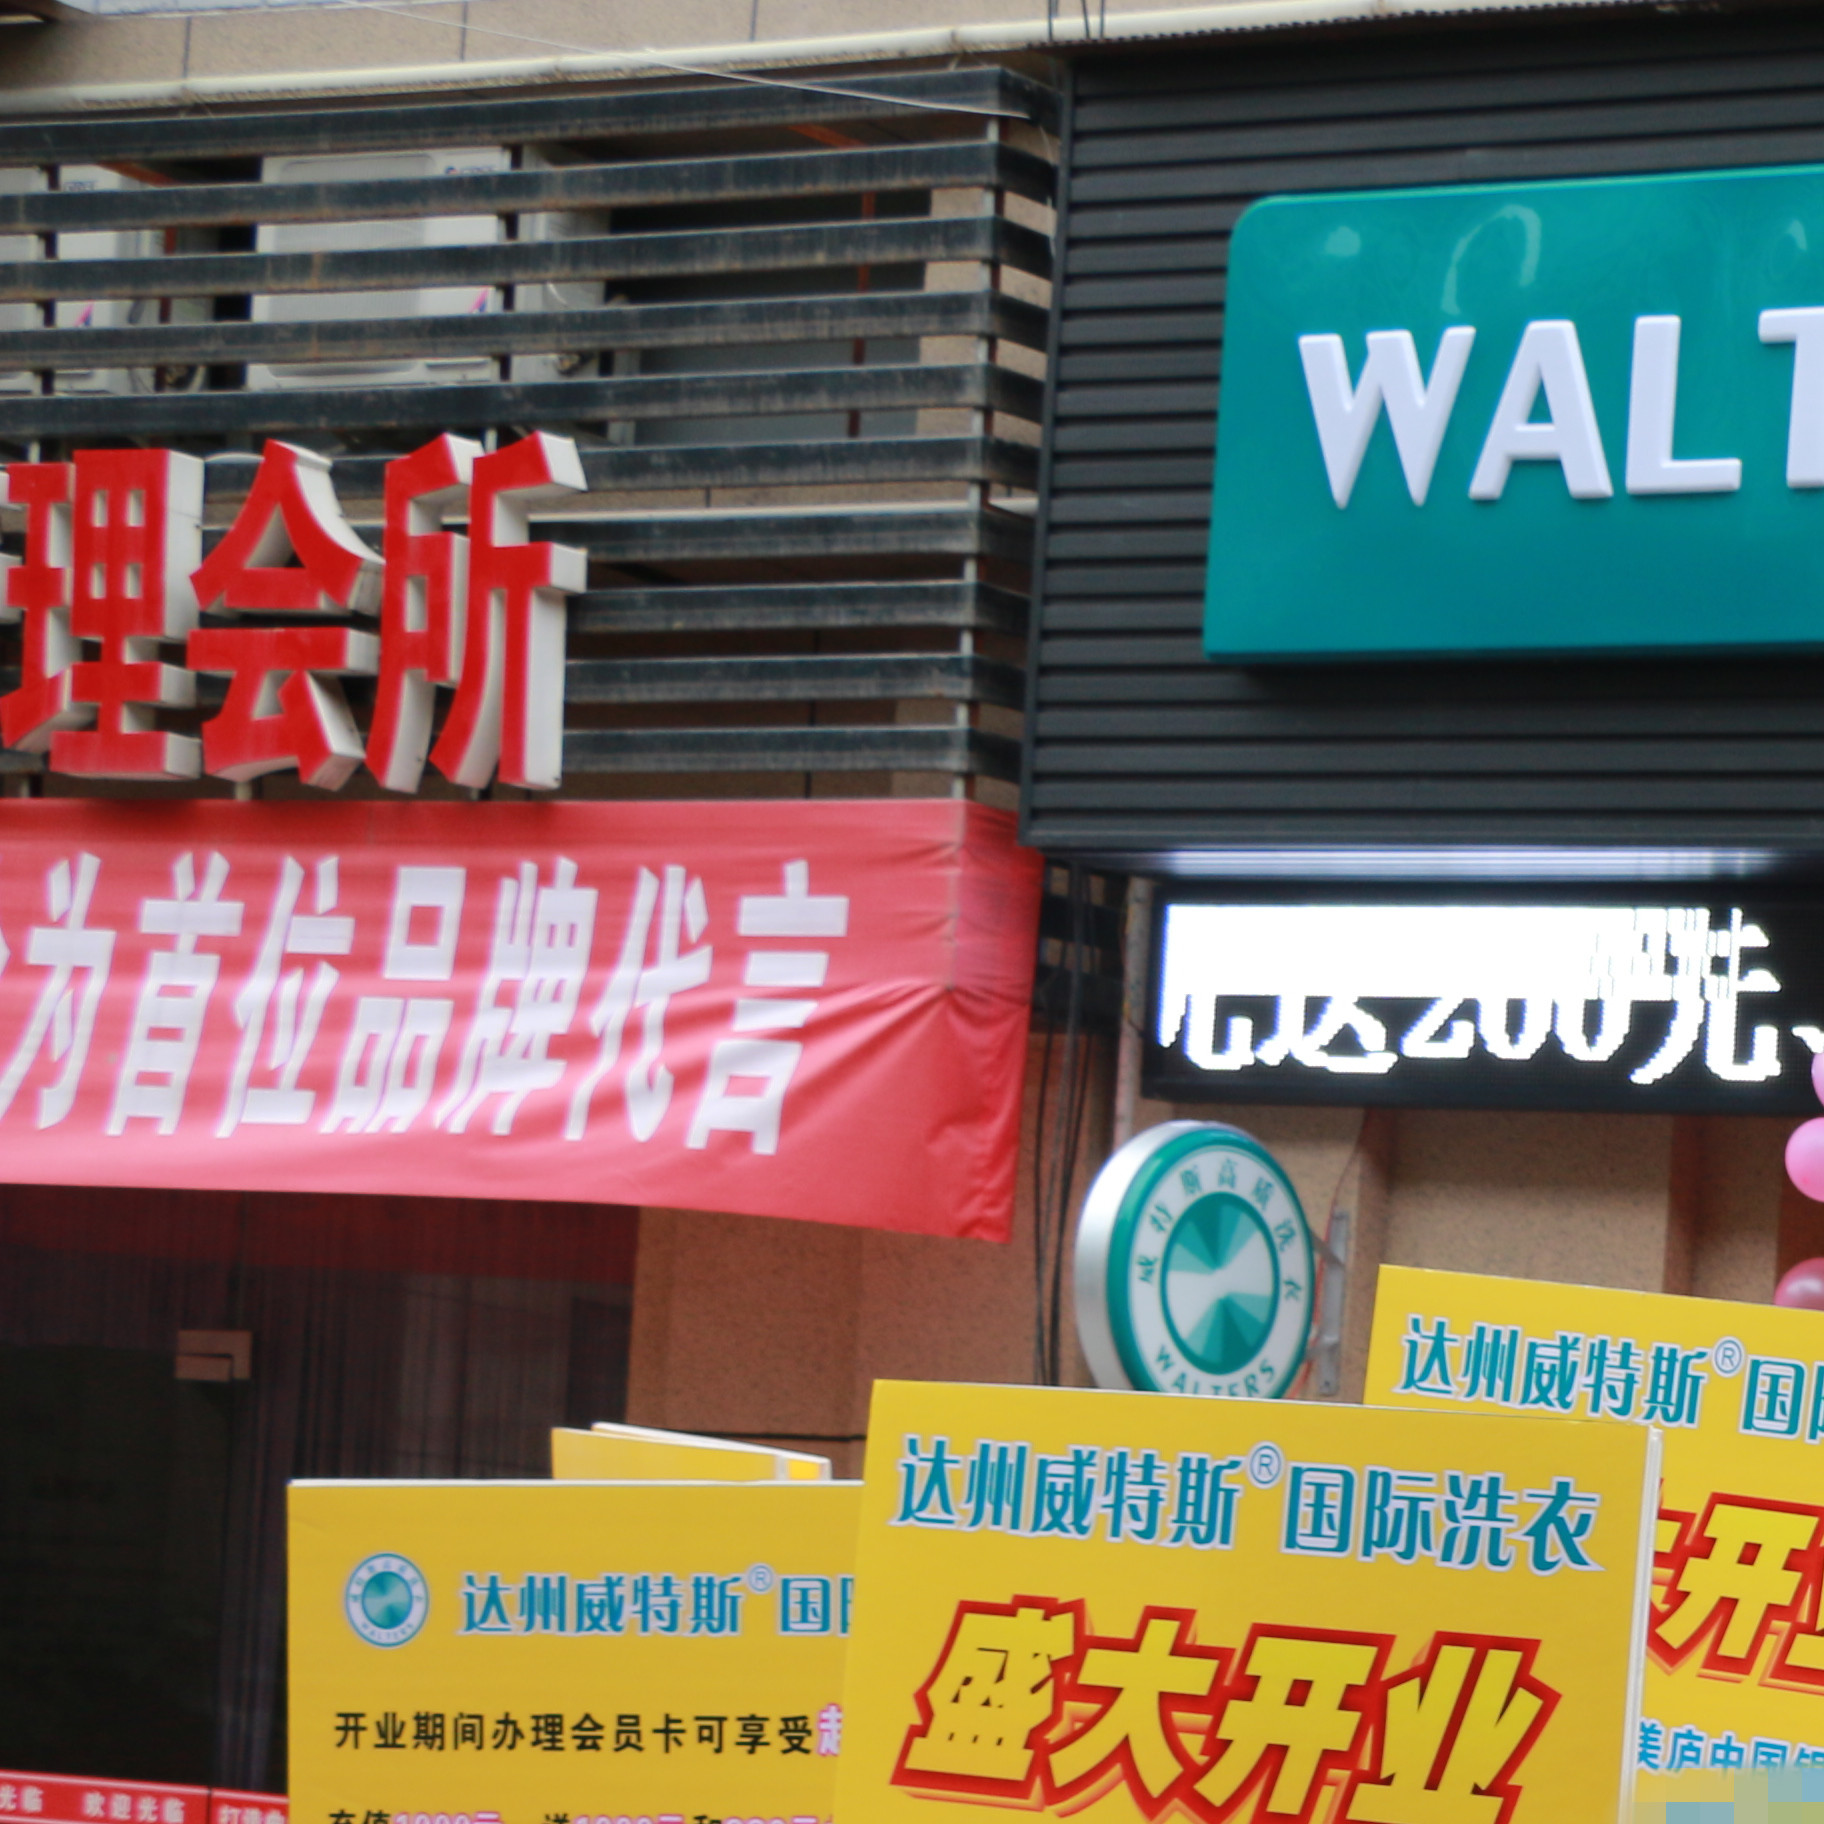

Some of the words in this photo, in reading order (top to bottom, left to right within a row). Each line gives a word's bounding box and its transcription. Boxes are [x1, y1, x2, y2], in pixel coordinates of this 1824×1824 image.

[0, 432, 587, 791] 理会所
[0, 850, 850, 1157] 为首位品牌代言
[459, 1563, 855, 1637] 达州威特斯®国
